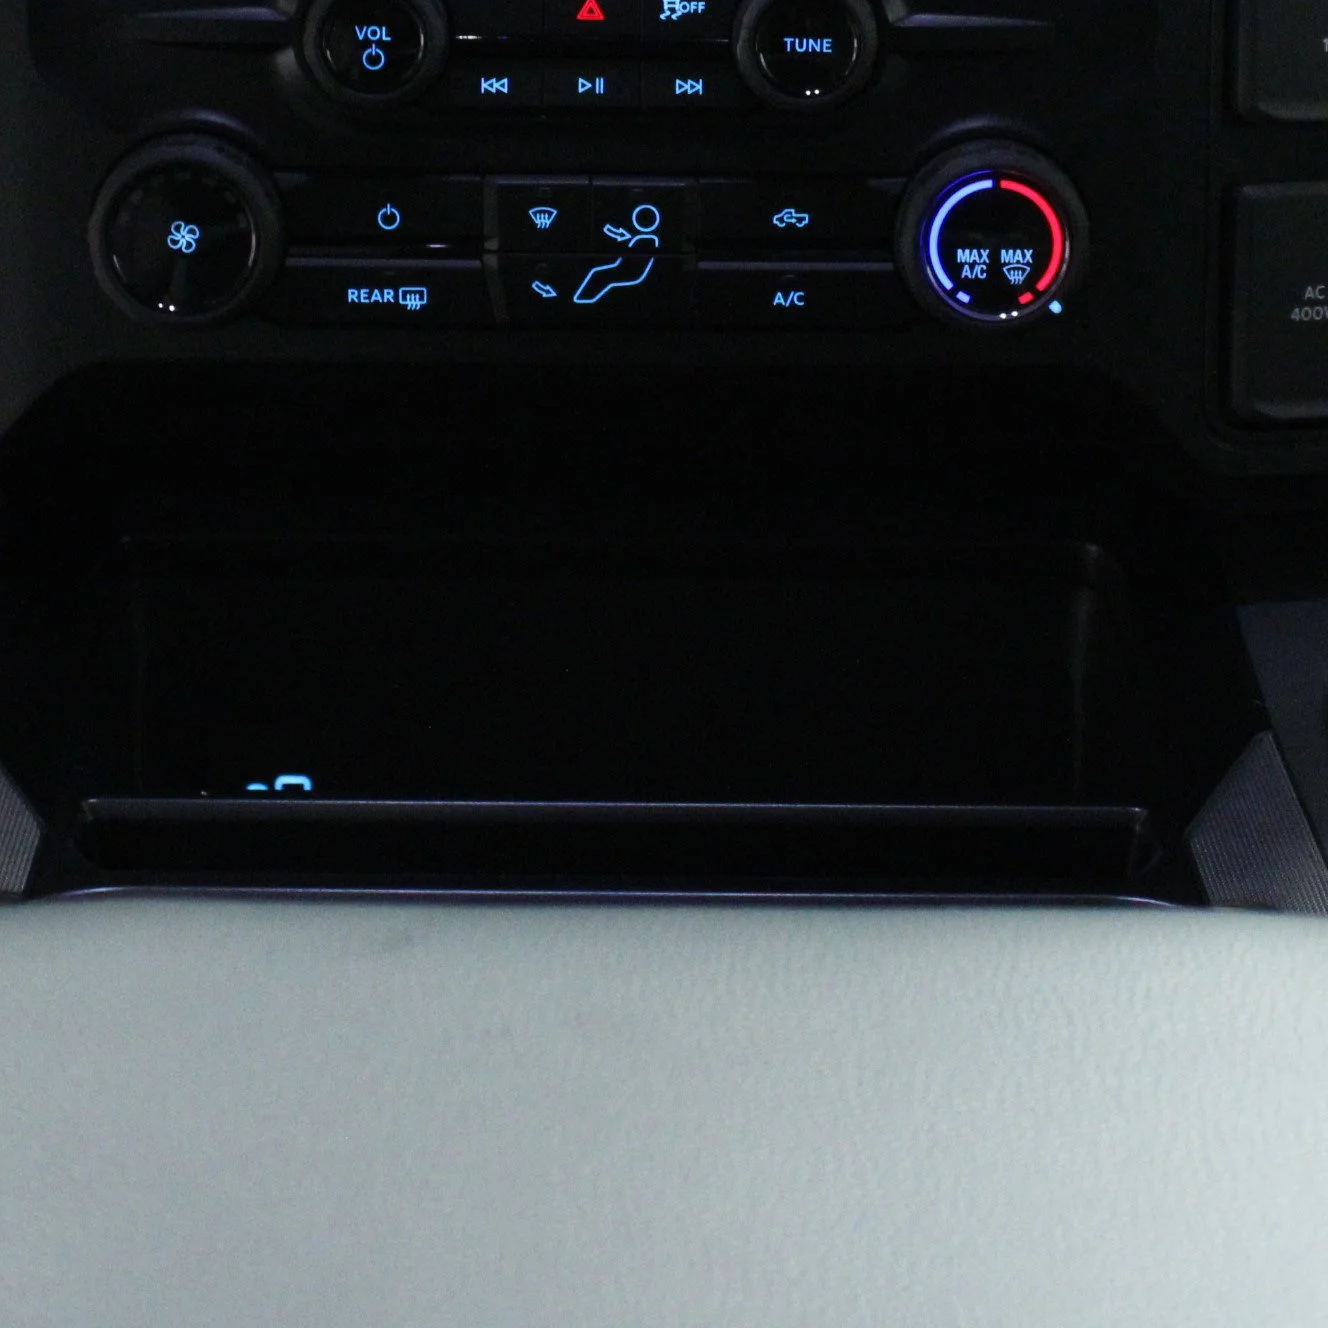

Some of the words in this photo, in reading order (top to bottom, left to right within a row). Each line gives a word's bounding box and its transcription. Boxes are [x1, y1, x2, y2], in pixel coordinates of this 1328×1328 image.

[678, 1, 706, 17] OFF
[355, 25, 392, 41] VOL
[783, 37, 833, 53] TUNE
[957, 248, 990, 264] MAX
[1000, 249, 1034, 264] MAX
[961, 264, 987, 279] A/C
[347, 288, 395, 303] REAR
[773, 291, 805, 307] A/C
[1304, 284, 1326, 300] AC
